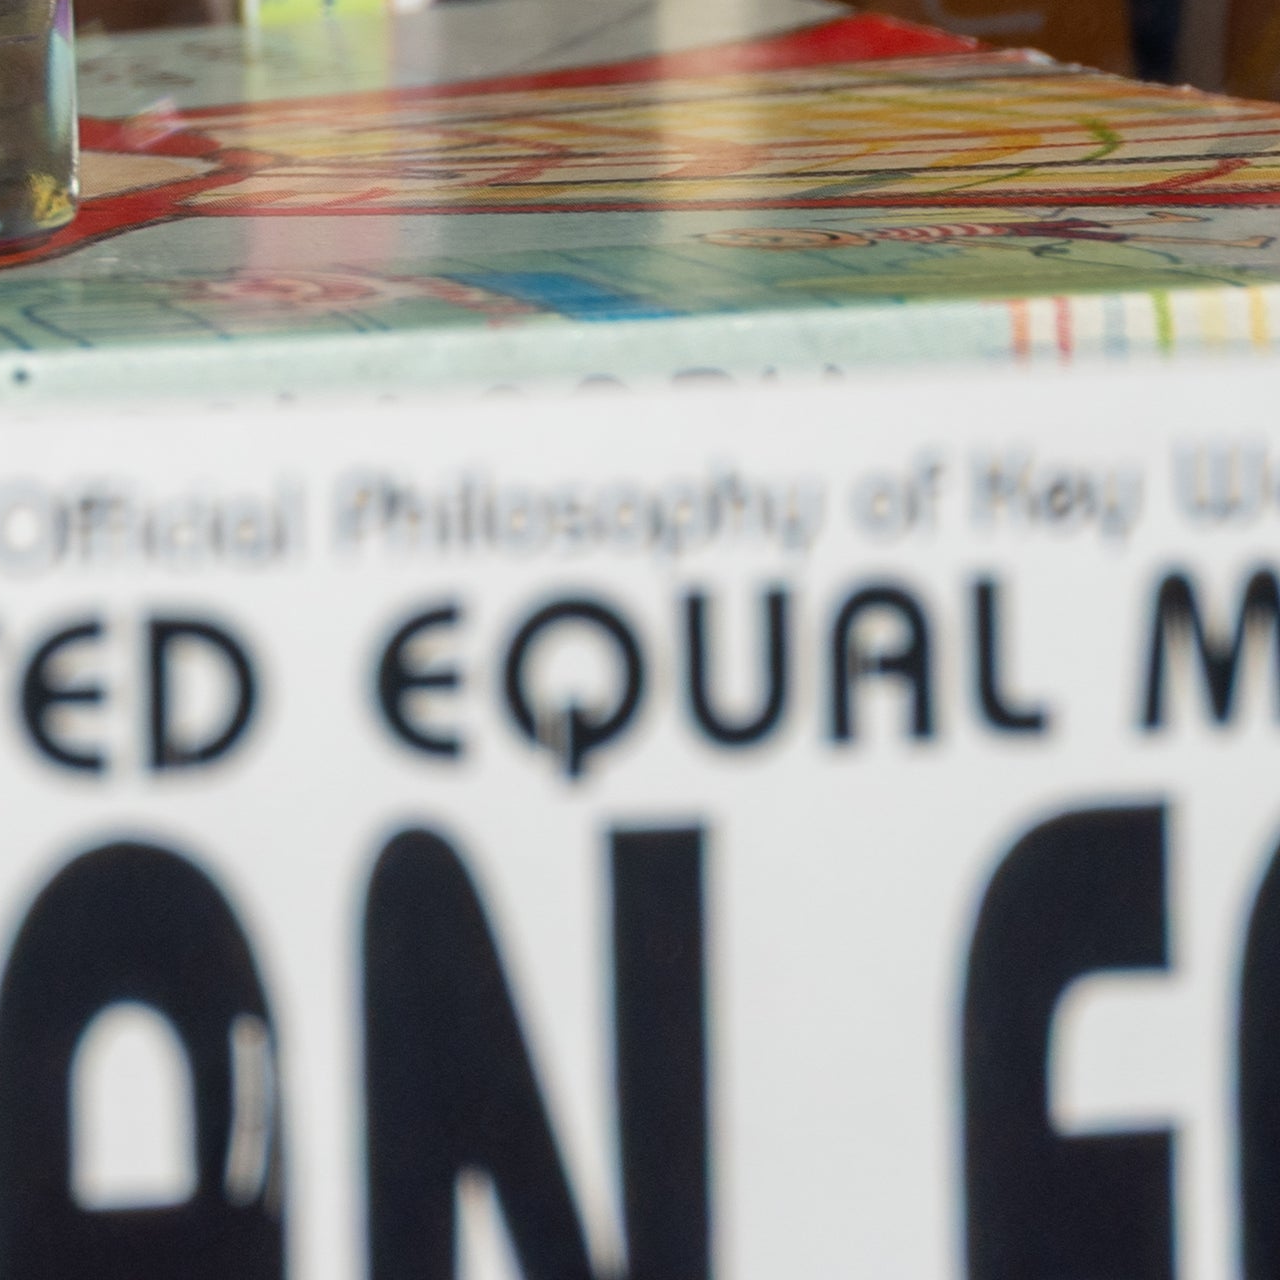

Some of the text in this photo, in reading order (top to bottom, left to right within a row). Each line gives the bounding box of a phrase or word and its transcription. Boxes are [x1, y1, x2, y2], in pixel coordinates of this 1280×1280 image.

[336, 462, 826, 559] Philosophy
[846, 448, 944, 532] of
[378, 574, 1050, 782] EQUAL
